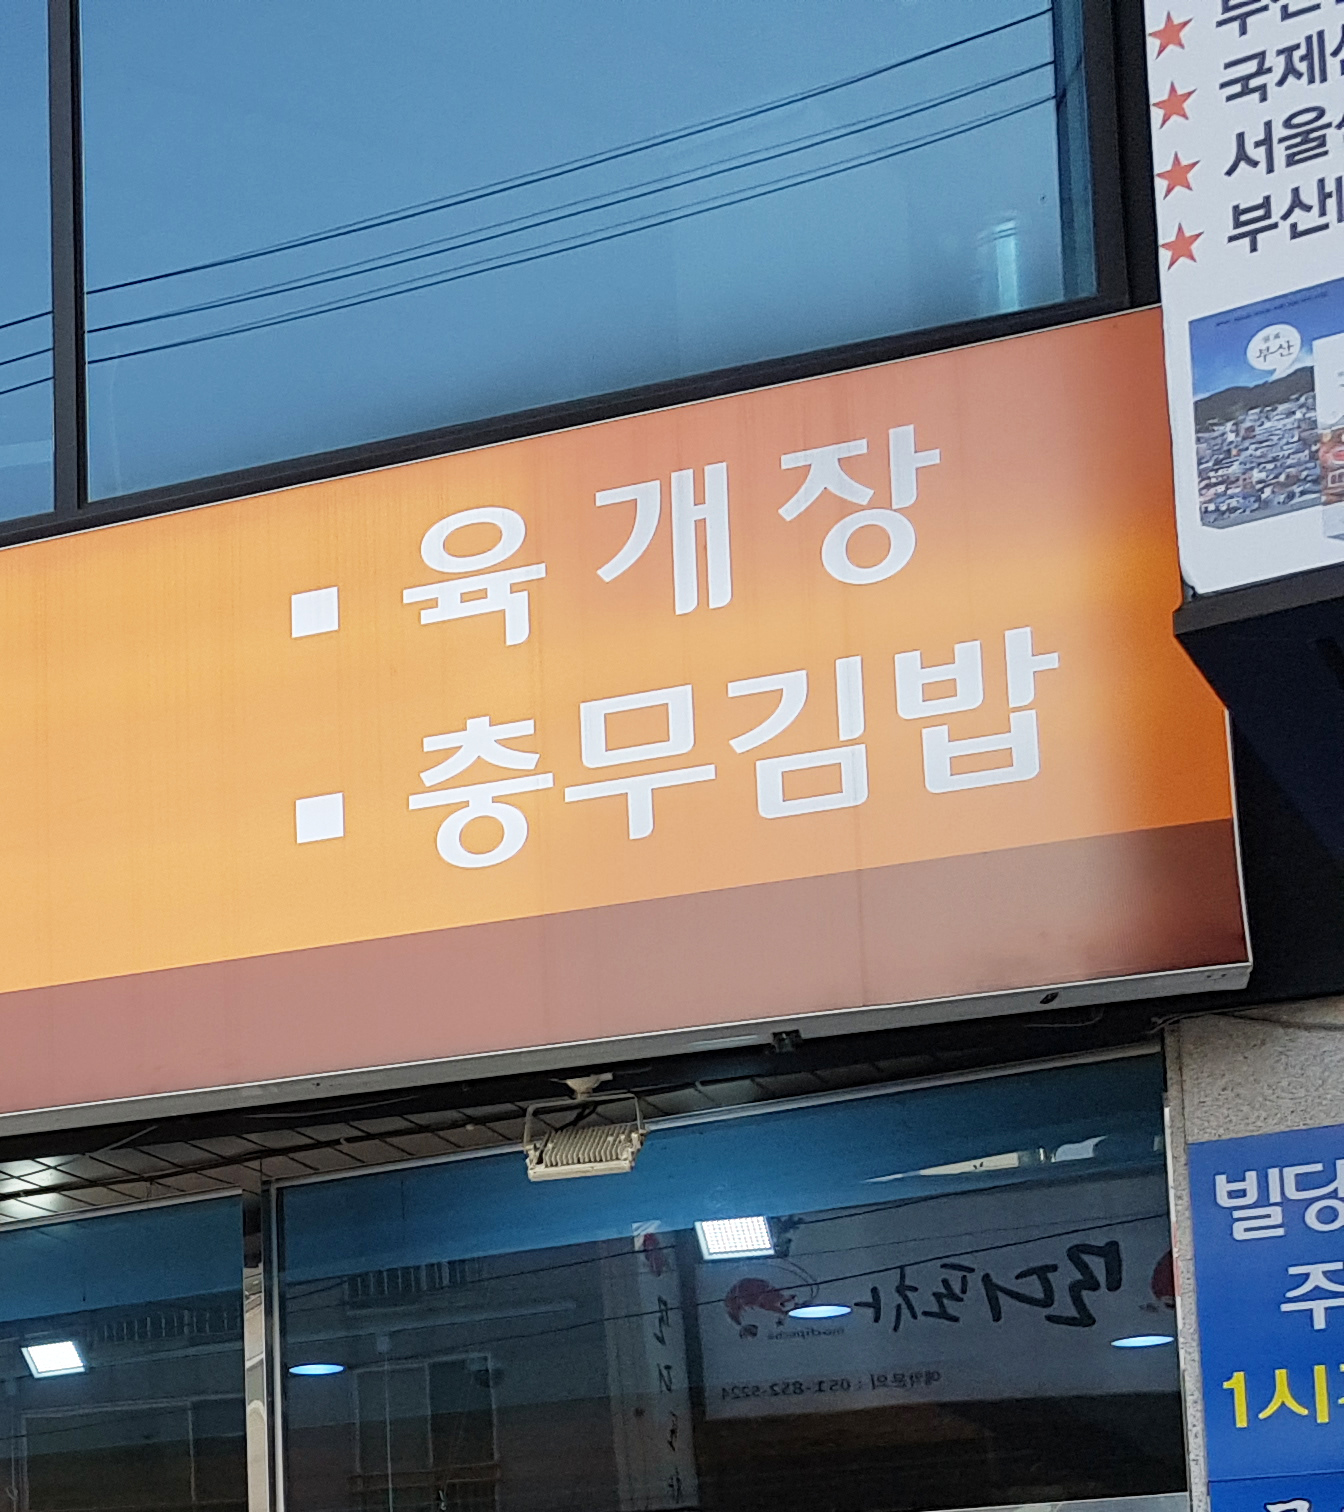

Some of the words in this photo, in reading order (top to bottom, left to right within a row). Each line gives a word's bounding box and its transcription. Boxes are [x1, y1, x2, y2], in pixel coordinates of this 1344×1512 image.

[1224, 106, 1344, 177] 서울
[1227, 176, 1344, 253] 부산
[403, 424, 941, 646] 육개장
[409, 626, 1059, 868] 충무김밥
[1222, 1364, 1344, 1428] 1시
